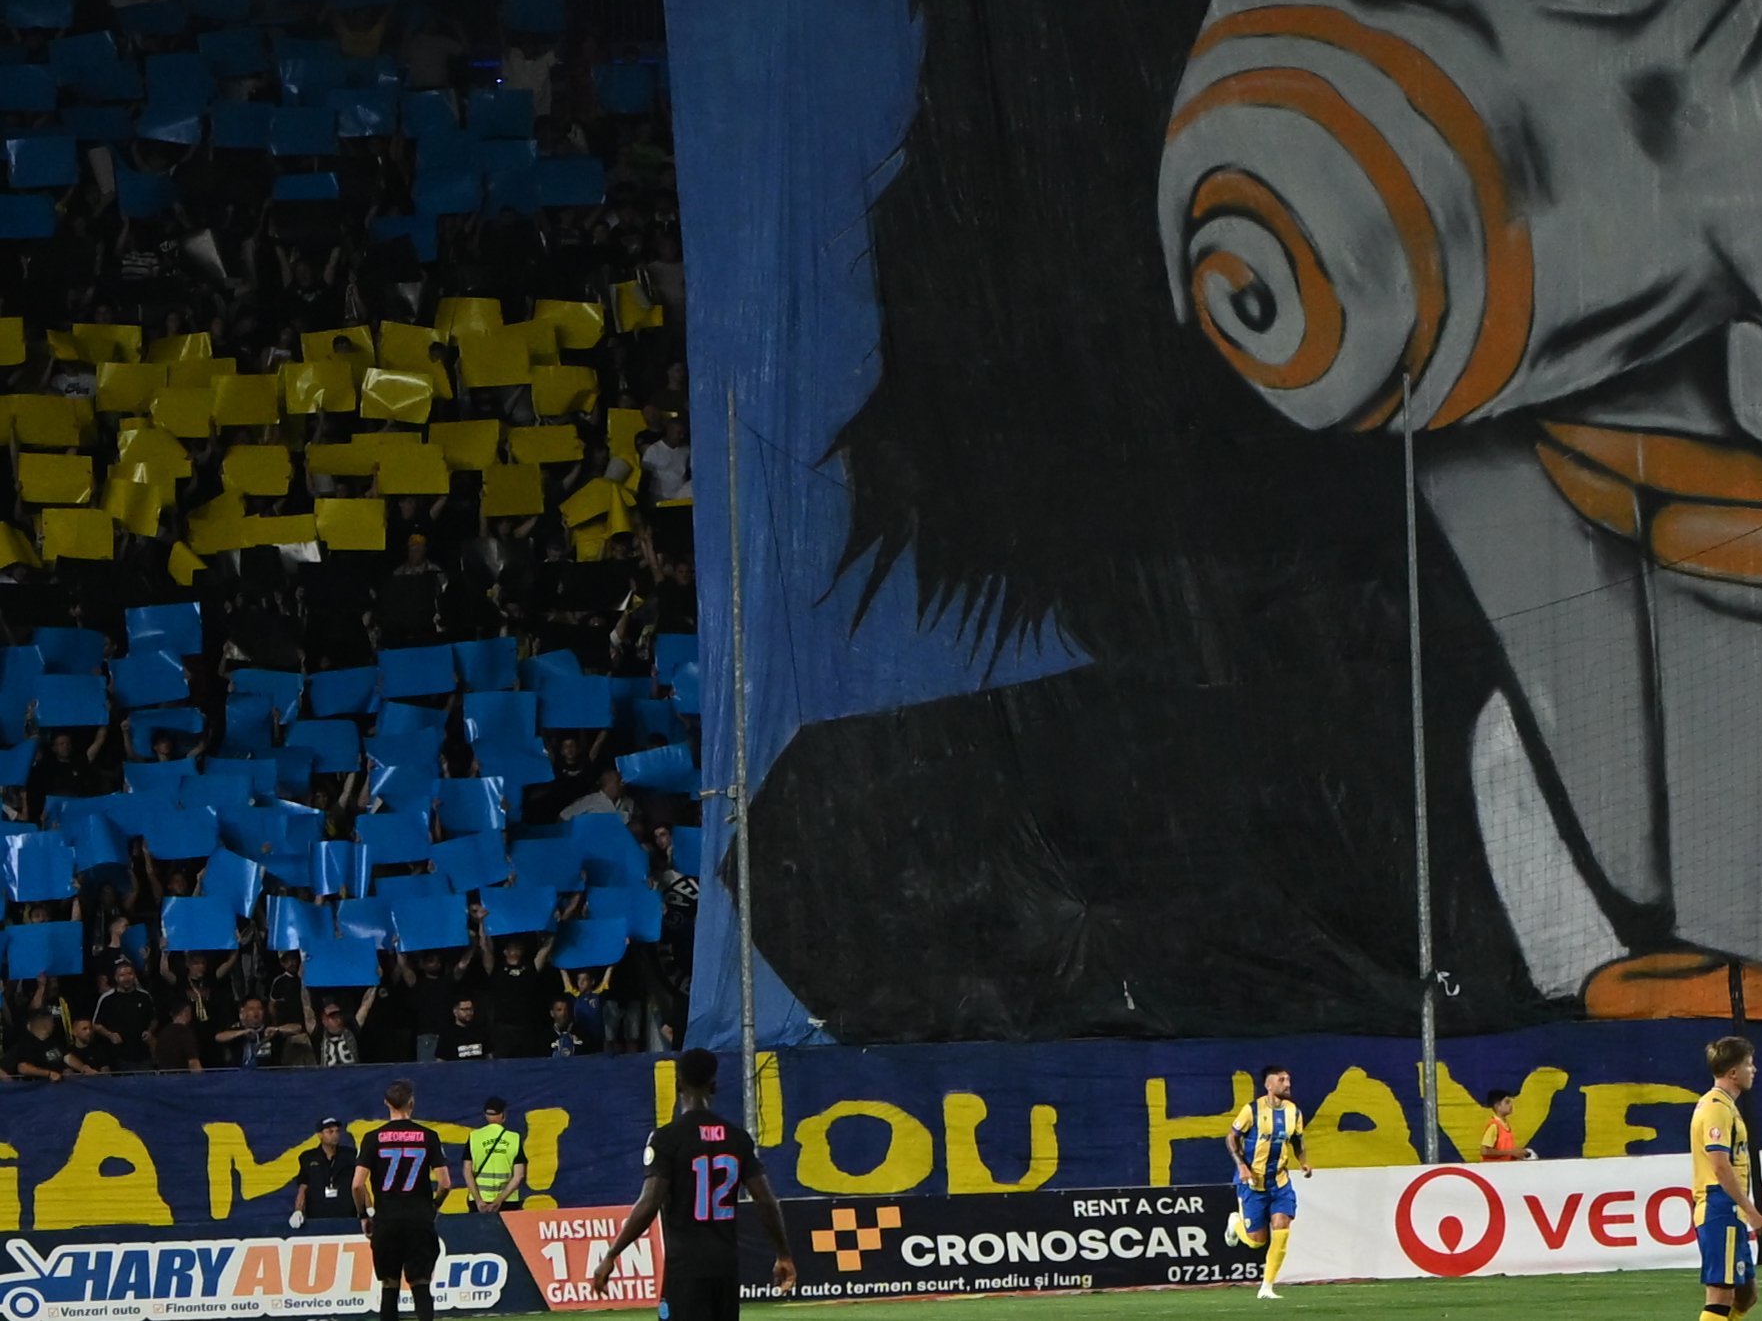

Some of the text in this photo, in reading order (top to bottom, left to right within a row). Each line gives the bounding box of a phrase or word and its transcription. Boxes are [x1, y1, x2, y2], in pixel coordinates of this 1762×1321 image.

[698, 1125, 726, 1141] KIKI
[0, 1107, 570, 1230] AM!
[378, 1147, 427, 1192] 77
[691, 1153, 740, 1221] 12
[1073, 1196, 1205, 1218] RENT A CAR
[539, 1218, 616, 1240] MASINI
[901, 1226, 1210, 1267] CRONOSCAR
[540, 1238, 655, 1280] 1 AN
[801, 1284, 842, 1296] auto
[847, 1280, 912, 1294] termen
[917, 1277, 970, 1292] scurt,
[975, 1273, 1030, 1290] mediu
[1053, 1272, 1093, 1288] lung
[284, 1297, 365, 1308] Service auto
[472, 1290, 493, 1301] ITP
[60, 1305, 141, 1317] Vanzari auto
[165, 1301, 260, 1313] Finantare auto
